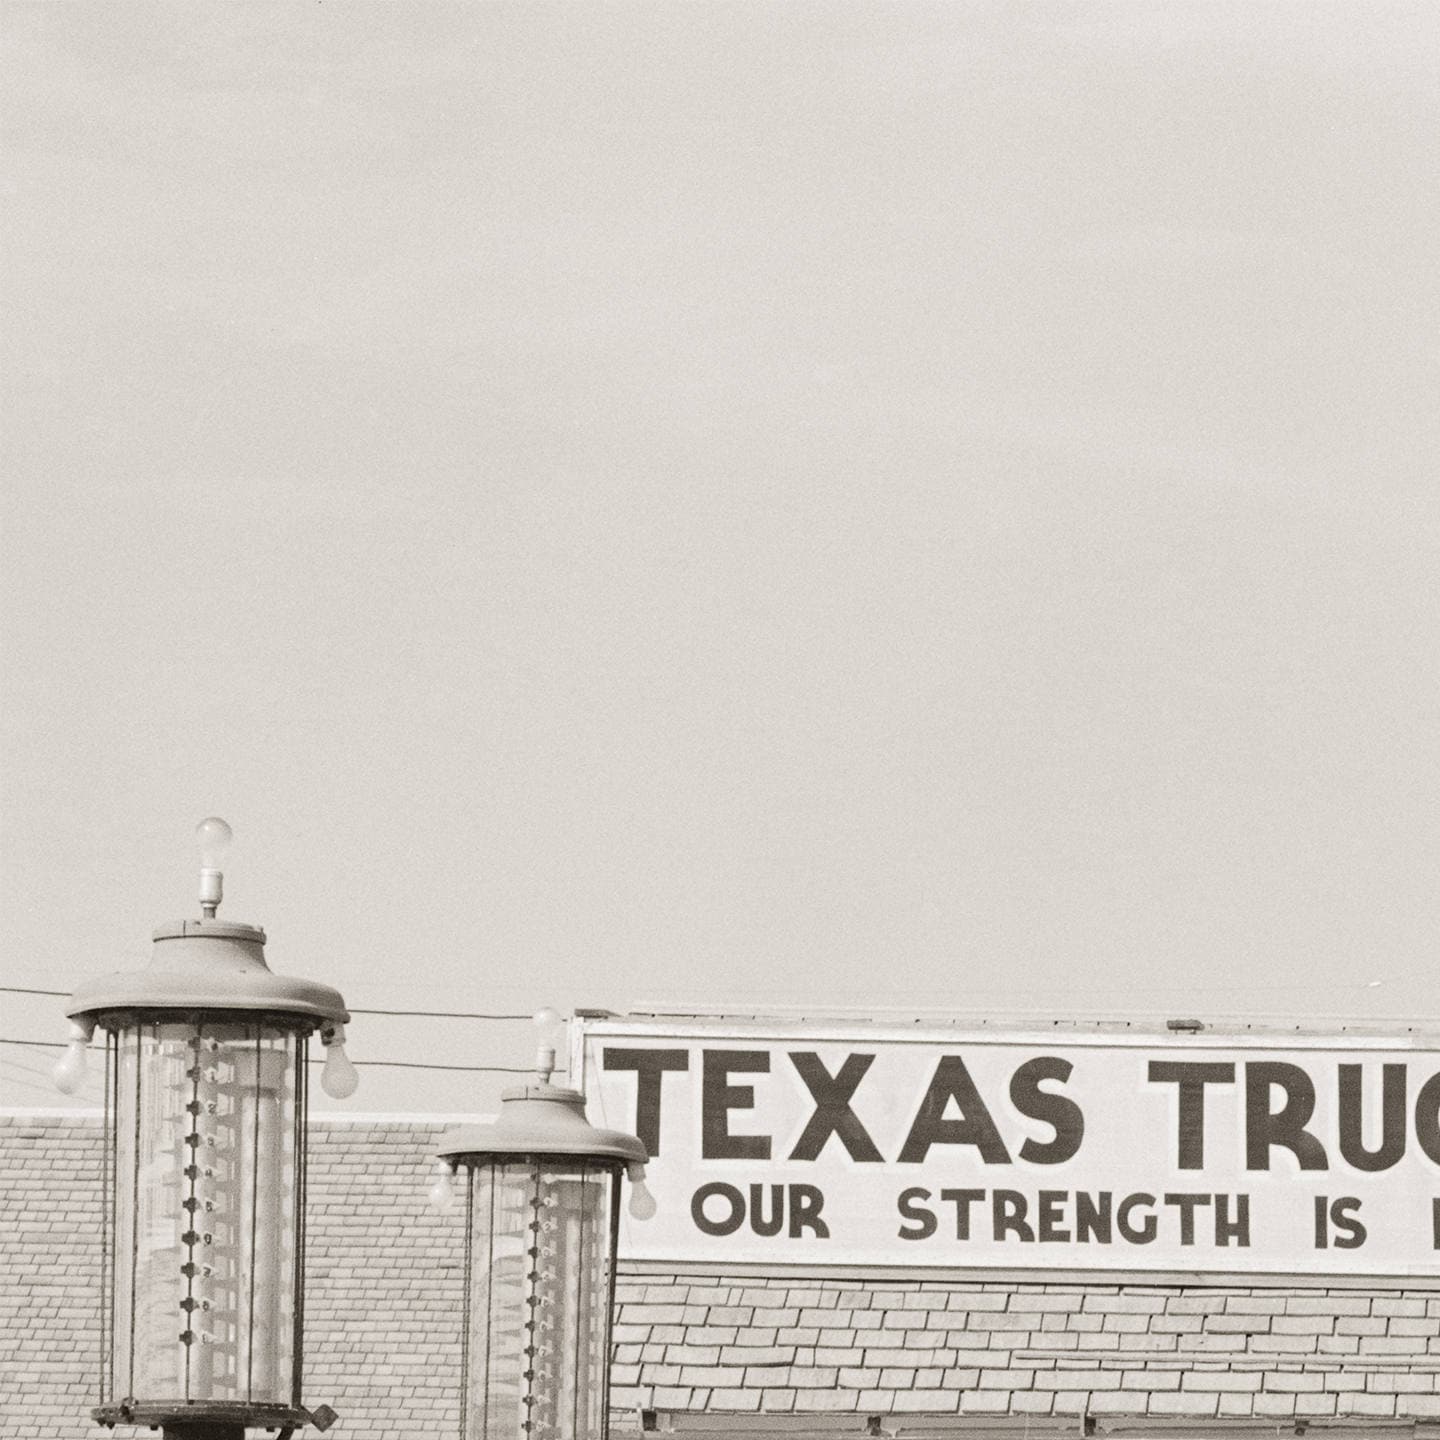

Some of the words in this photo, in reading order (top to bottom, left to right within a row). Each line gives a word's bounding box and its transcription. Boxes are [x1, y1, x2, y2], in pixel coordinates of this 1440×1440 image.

[602, 1047, 1085, 1165] TEXAS
[690, 1181, 830, 1239] OUR
[897, 1187, 1251, 1248] STRENGTH
[1314, 1195, 1368, 1250] IS
